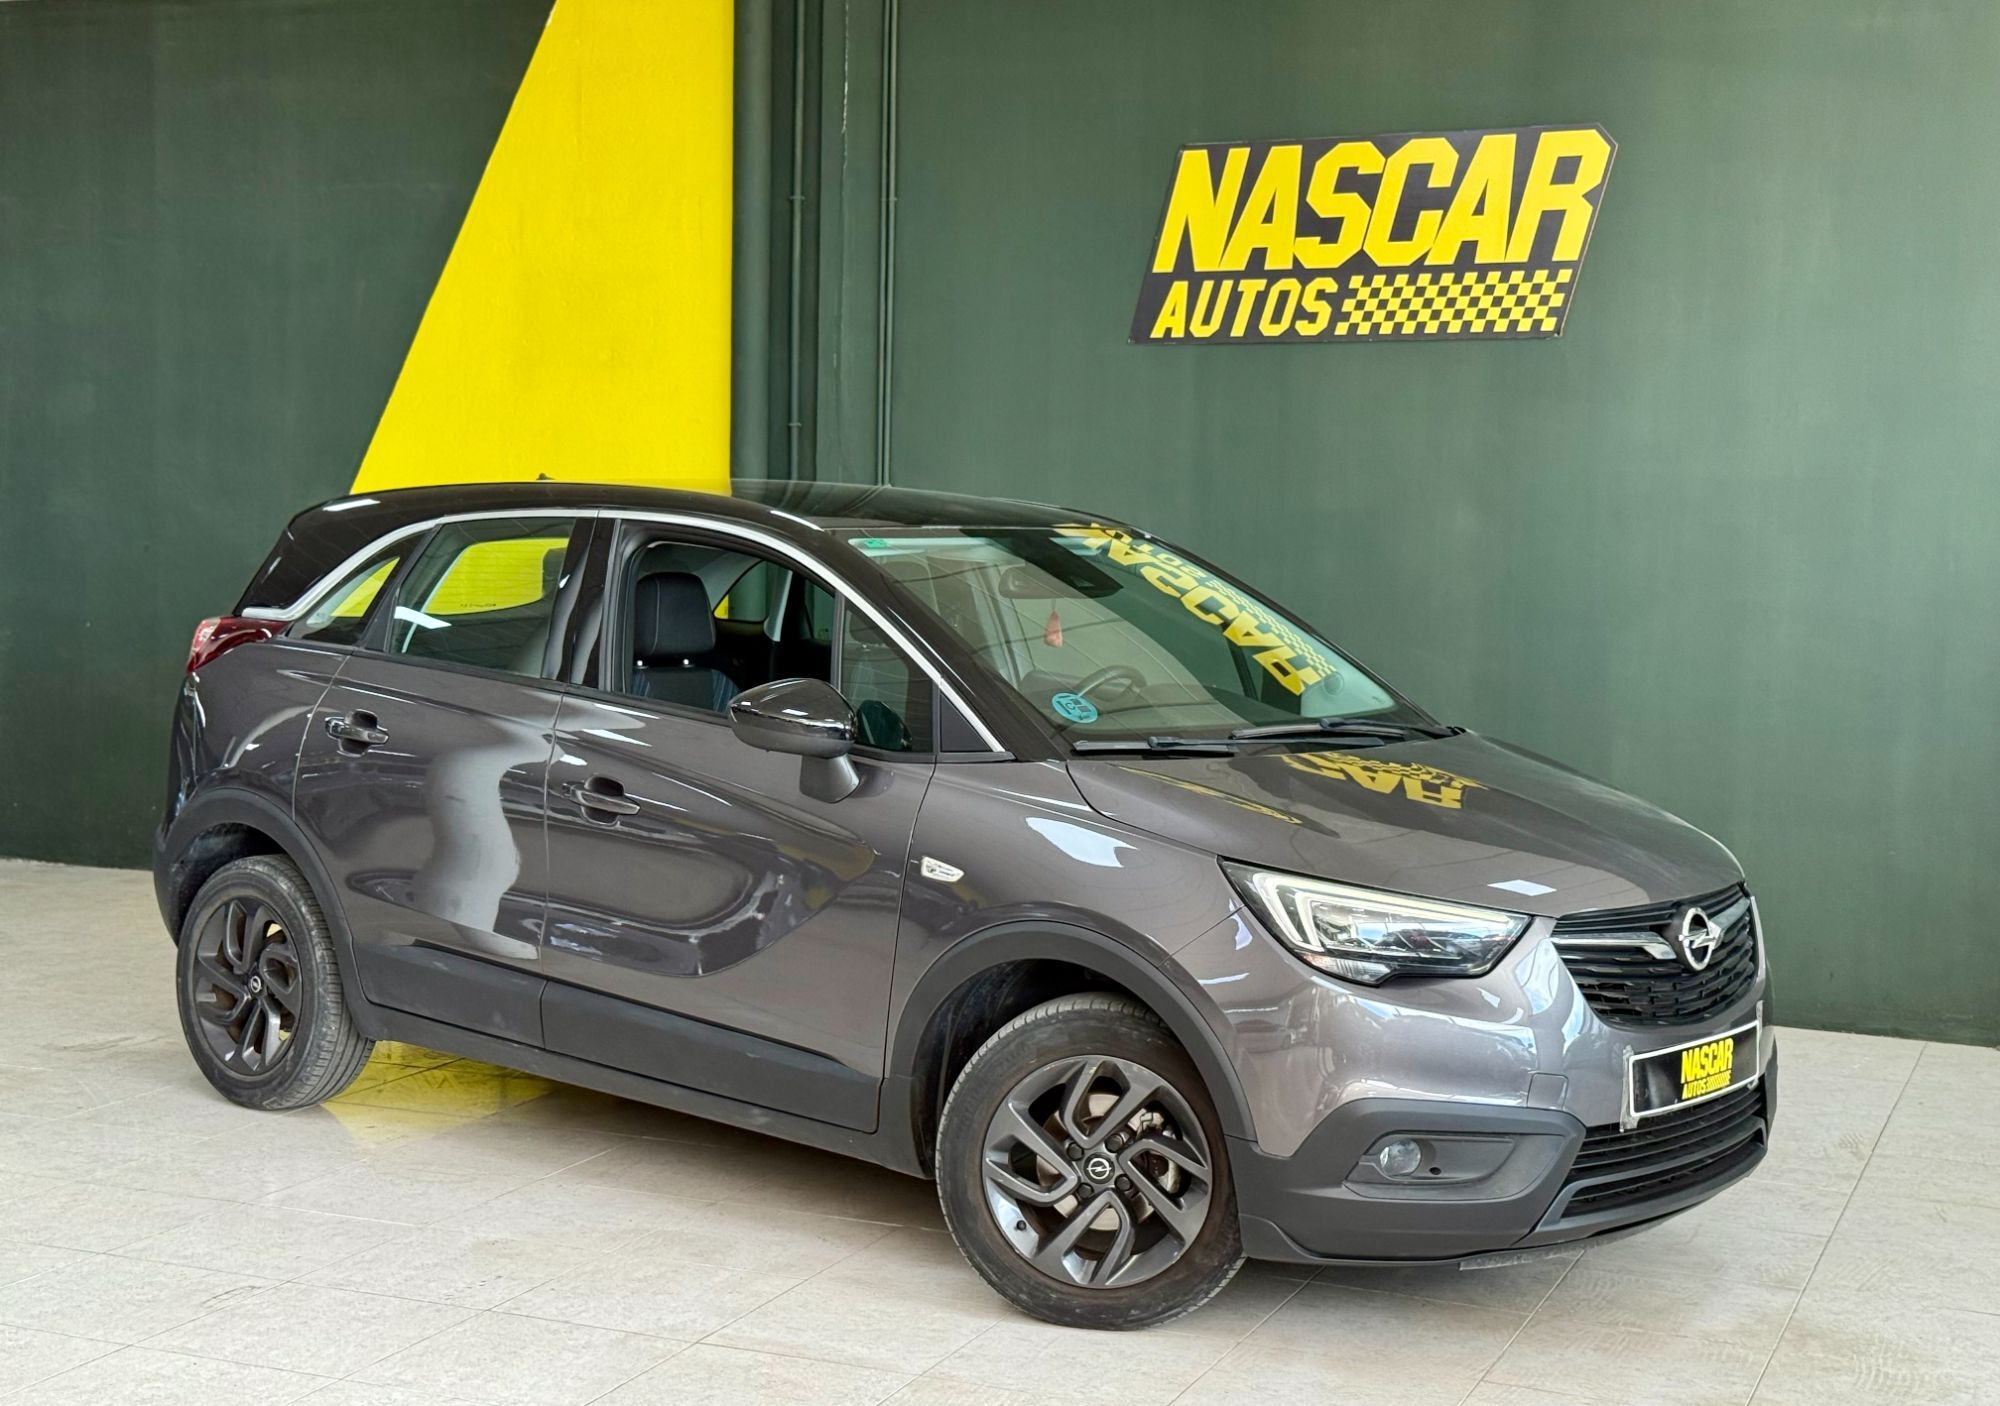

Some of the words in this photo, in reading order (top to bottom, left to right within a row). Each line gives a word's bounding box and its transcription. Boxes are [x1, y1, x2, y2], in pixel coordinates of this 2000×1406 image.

[1153, 129, 1610, 273] NASCAR
[1150, 277, 1338, 338] AUTOS
[1681, 1037, 1734, 1084] NASCAR
[1682, 1078, 1706, 1100] AUTOS
